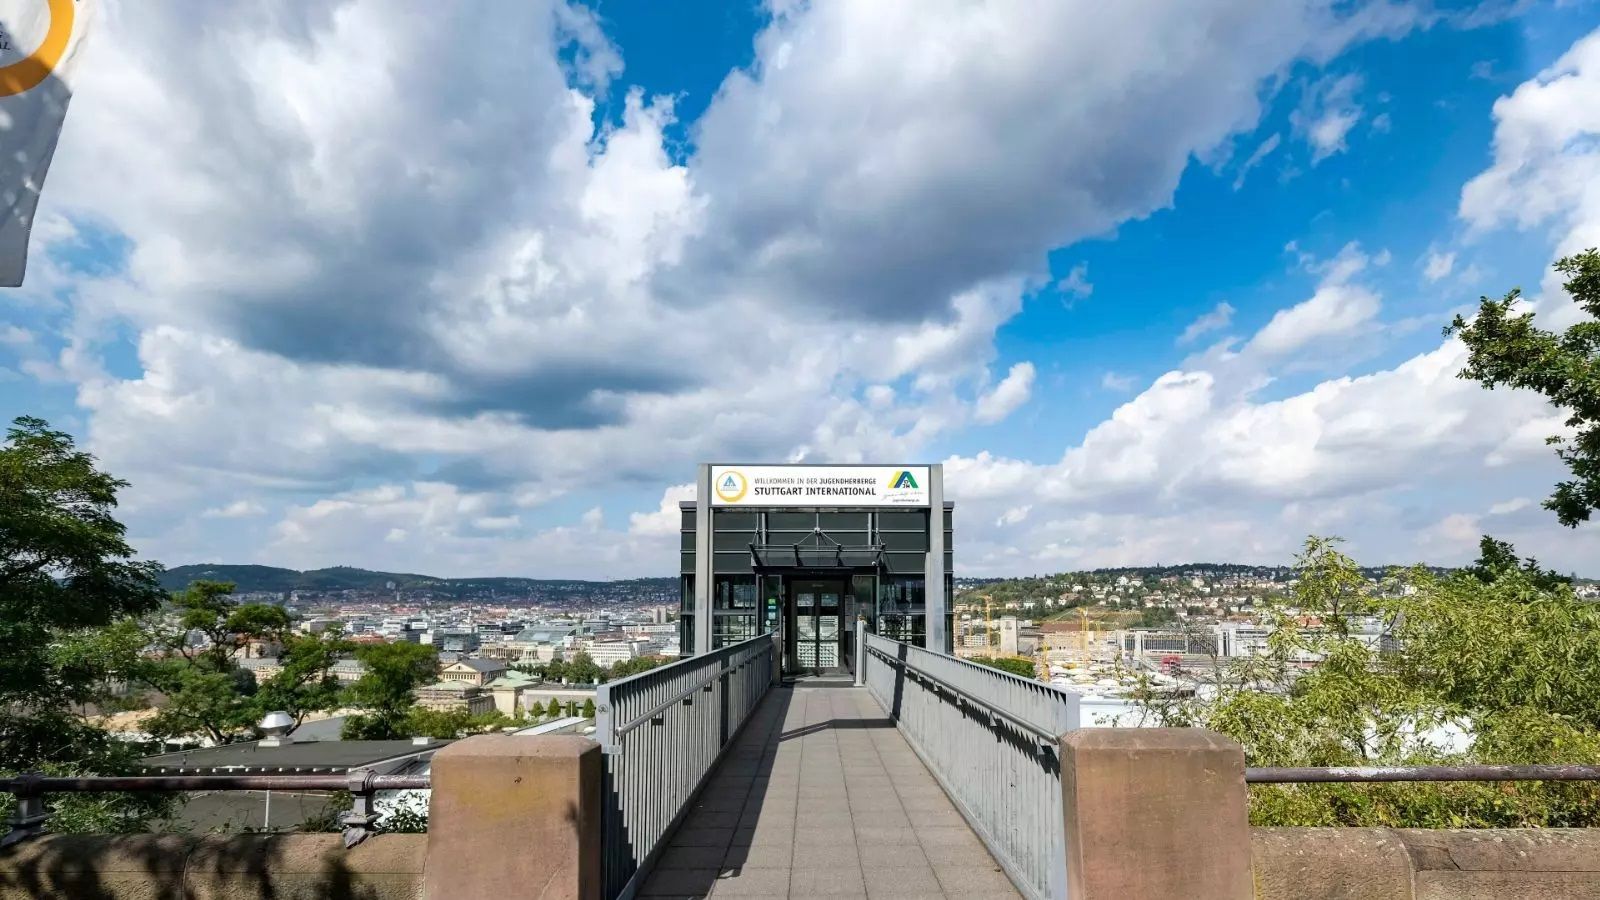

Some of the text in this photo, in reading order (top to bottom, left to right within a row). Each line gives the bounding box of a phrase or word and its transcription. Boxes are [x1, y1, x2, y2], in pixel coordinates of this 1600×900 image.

[754, 477, 877, 485] WILLKOMMEN IN DER JUGENDHERBERGE
[754, 487, 803, 496] STUTTGART
[805, 487, 877, 496] INTERNATIONAL
